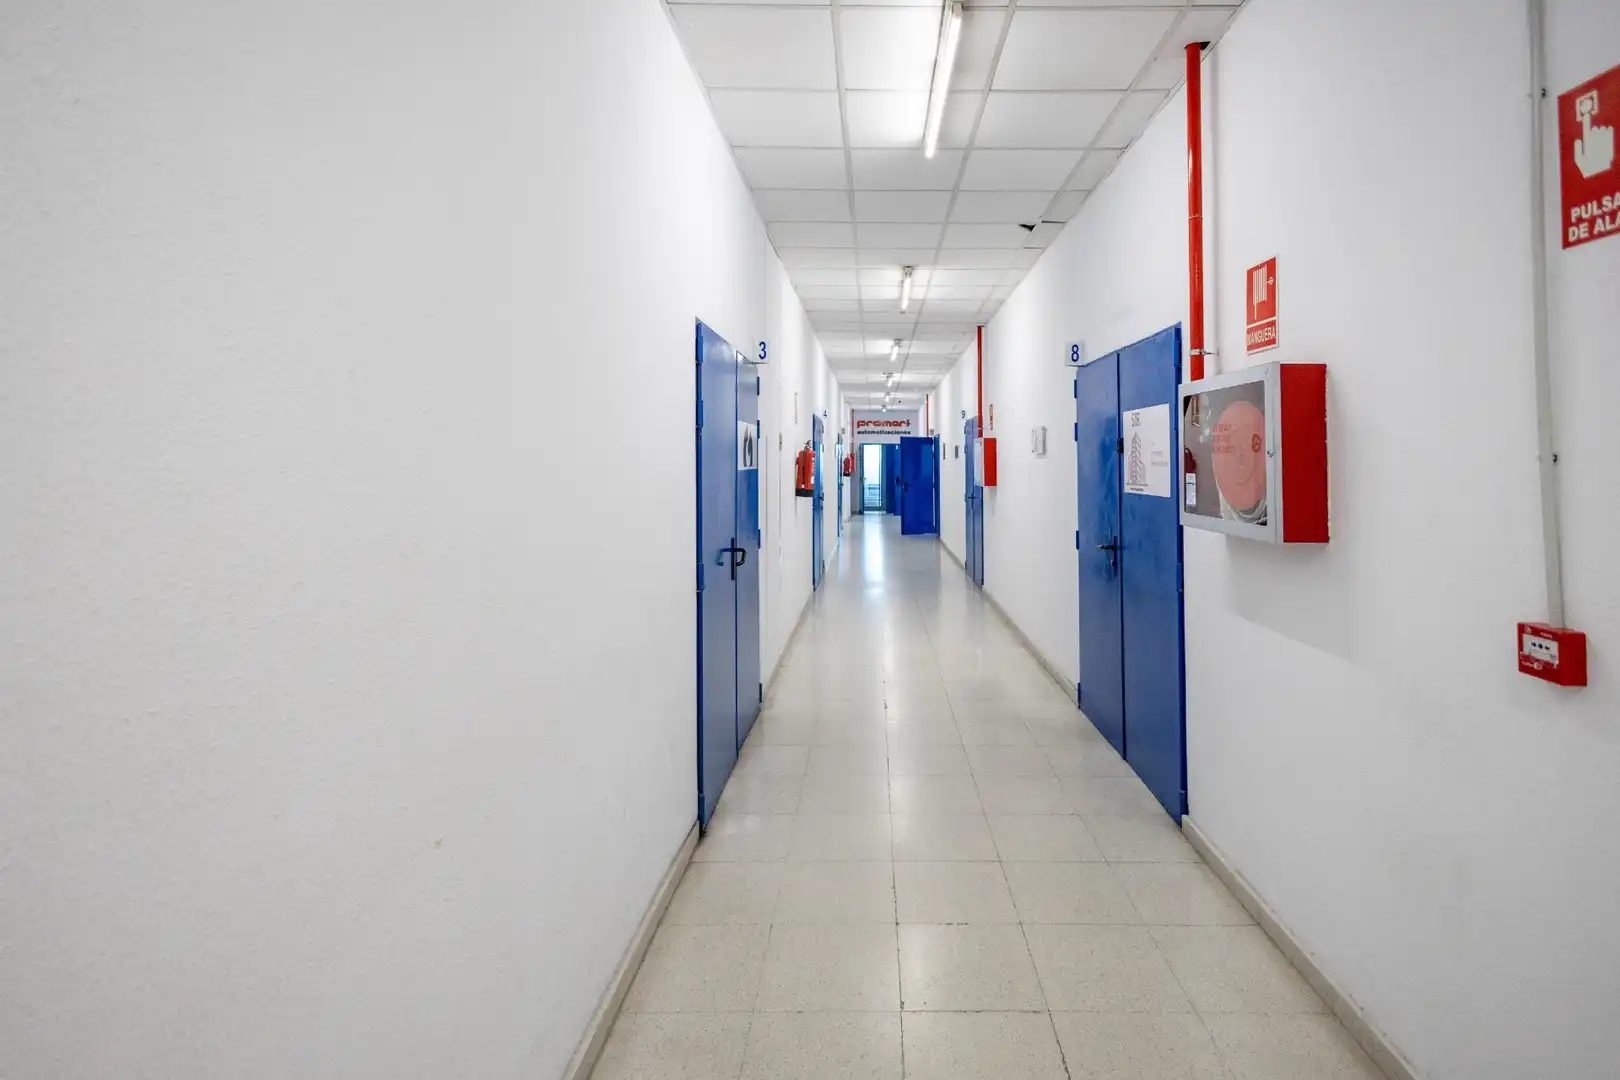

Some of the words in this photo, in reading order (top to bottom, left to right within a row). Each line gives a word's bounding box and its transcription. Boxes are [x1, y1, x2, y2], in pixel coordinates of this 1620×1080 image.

[1570, 191, 1620, 223] PULSA
[1568, 222, 1590, 243] DE
[1247, 326, 1276, 345] MANGUERA
[758, 341, 767, 360] 3
[1071, 344, 1080, 362] 8
[856, 419, 912, 429] promart
